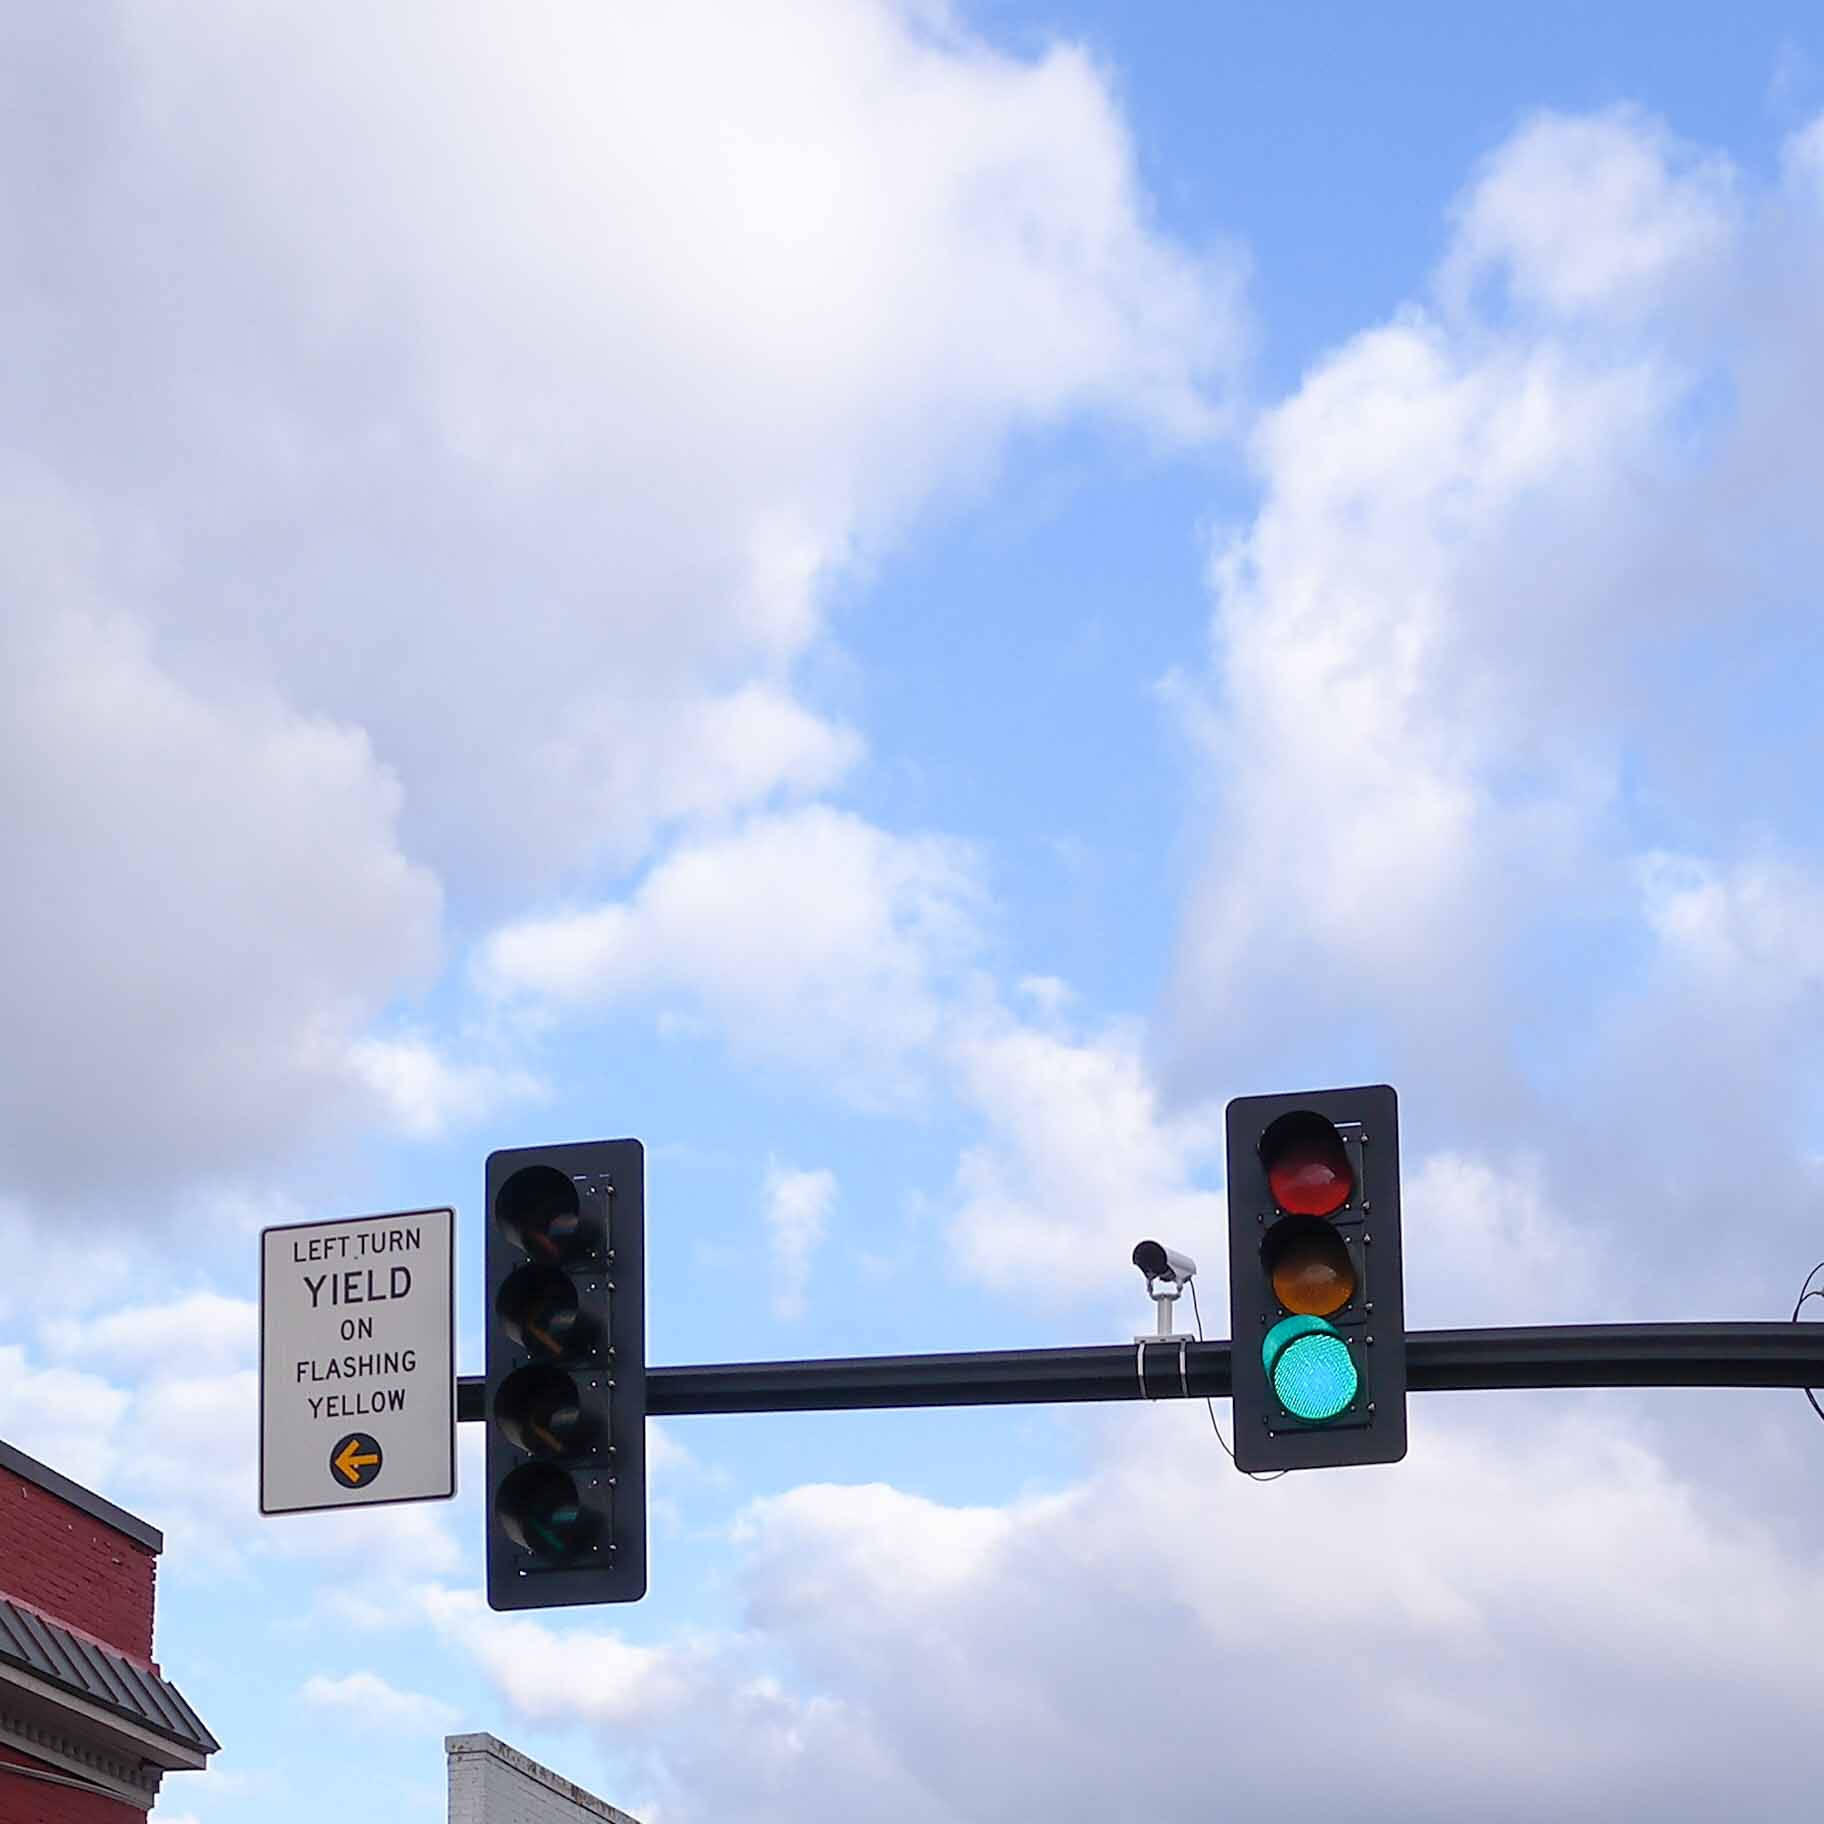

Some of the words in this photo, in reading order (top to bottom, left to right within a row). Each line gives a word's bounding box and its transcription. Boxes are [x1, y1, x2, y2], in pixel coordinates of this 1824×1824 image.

[293, 1235, 351, 1263] LEFT
[356, 1227, 421, 1255] TURN
[302, 1265, 412, 1308] YIELD
[340, 1316, 373, 1341] ON
[296, 1349, 417, 1384] FLASHING
[307, 1388, 406, 1420] YELLOW
